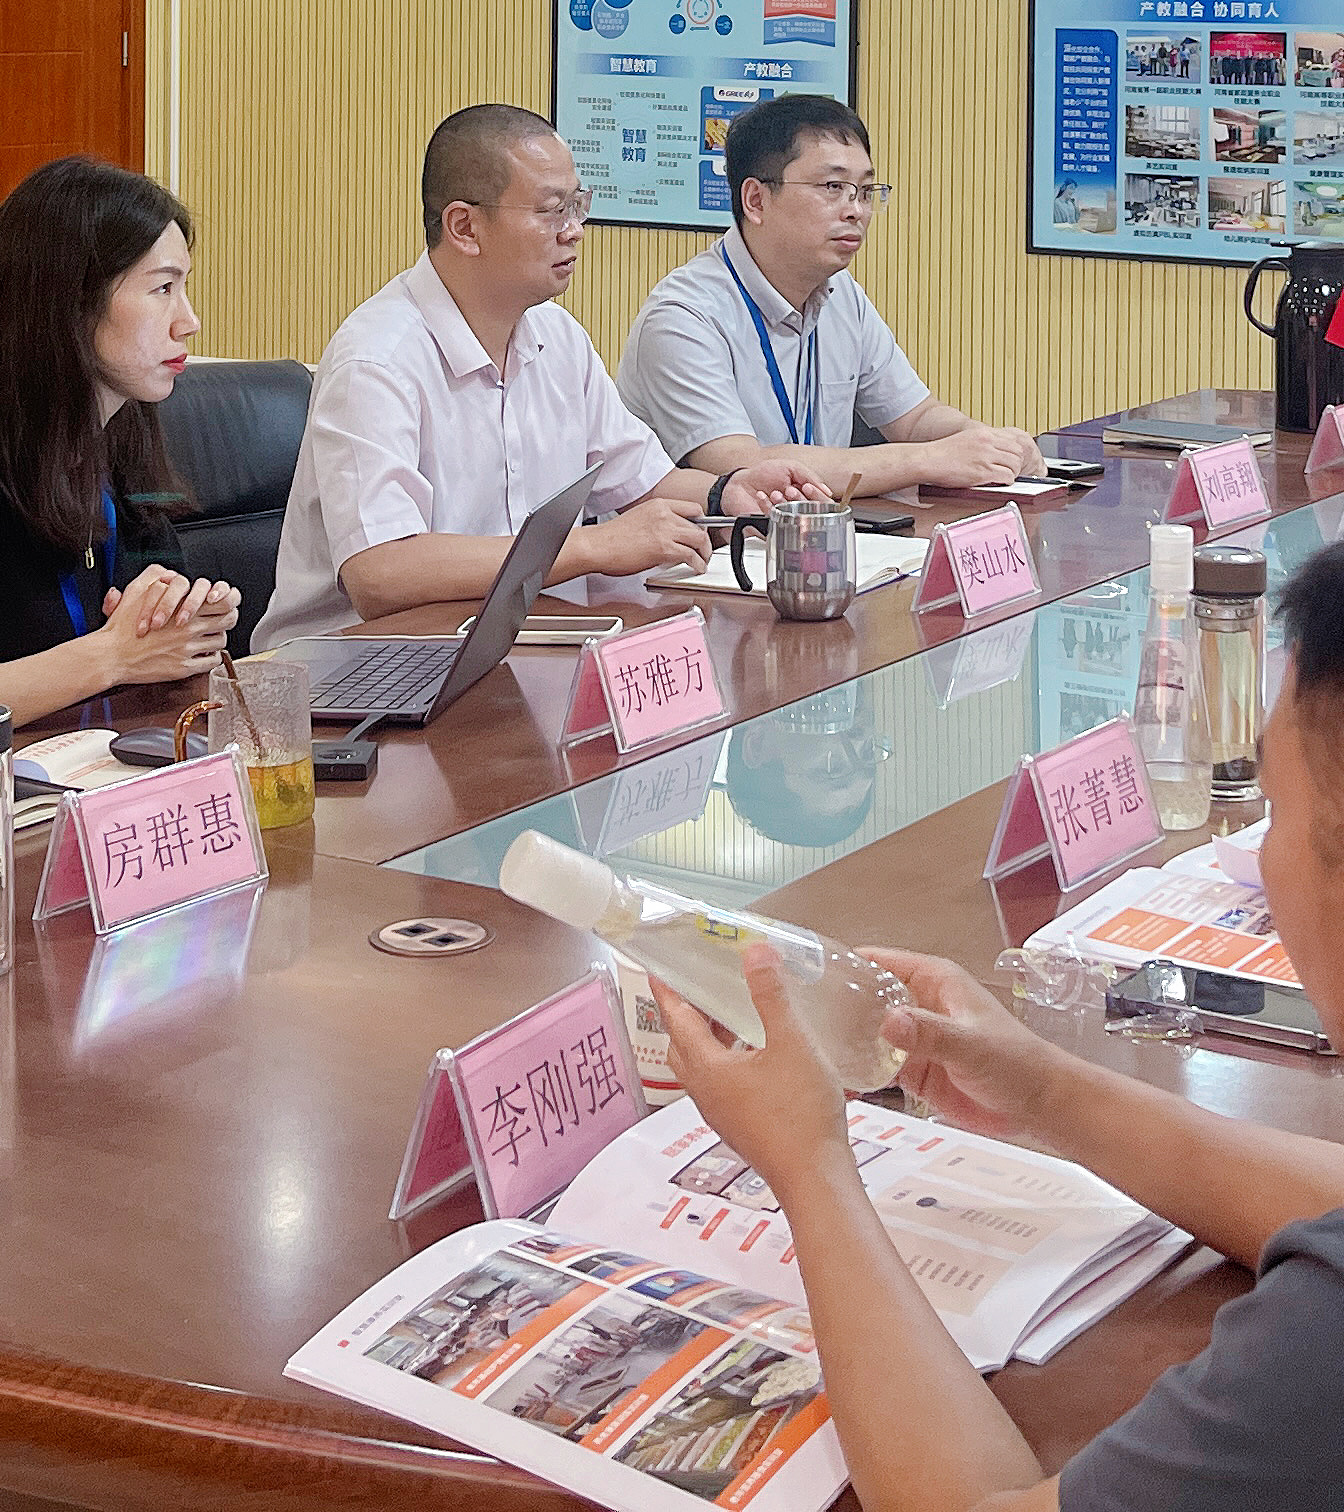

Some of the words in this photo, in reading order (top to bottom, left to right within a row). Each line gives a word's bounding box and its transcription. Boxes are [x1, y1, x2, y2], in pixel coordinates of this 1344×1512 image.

[1139, 0, 1205, 18] 产教融合
[1213, 2, 1280, 18] 协同育人
[609, 57, 657, 74] 智慧教育
[743, 62, 794, 78] 产教融合
[622, 128, 647, 144] 智慧
[622, 147, 646, 163] 教育
[1202, 460, 1256, 505] 刘高翔
[958, 533, 1026, 590] 樊山水
[614, 646, 702, 718] 苏雅方
[1049, 754, 1144, 846] 张菁慧
[102, 792, 242, 890] 房群惠
[480, 1025, 625, 1168] 李刚强
